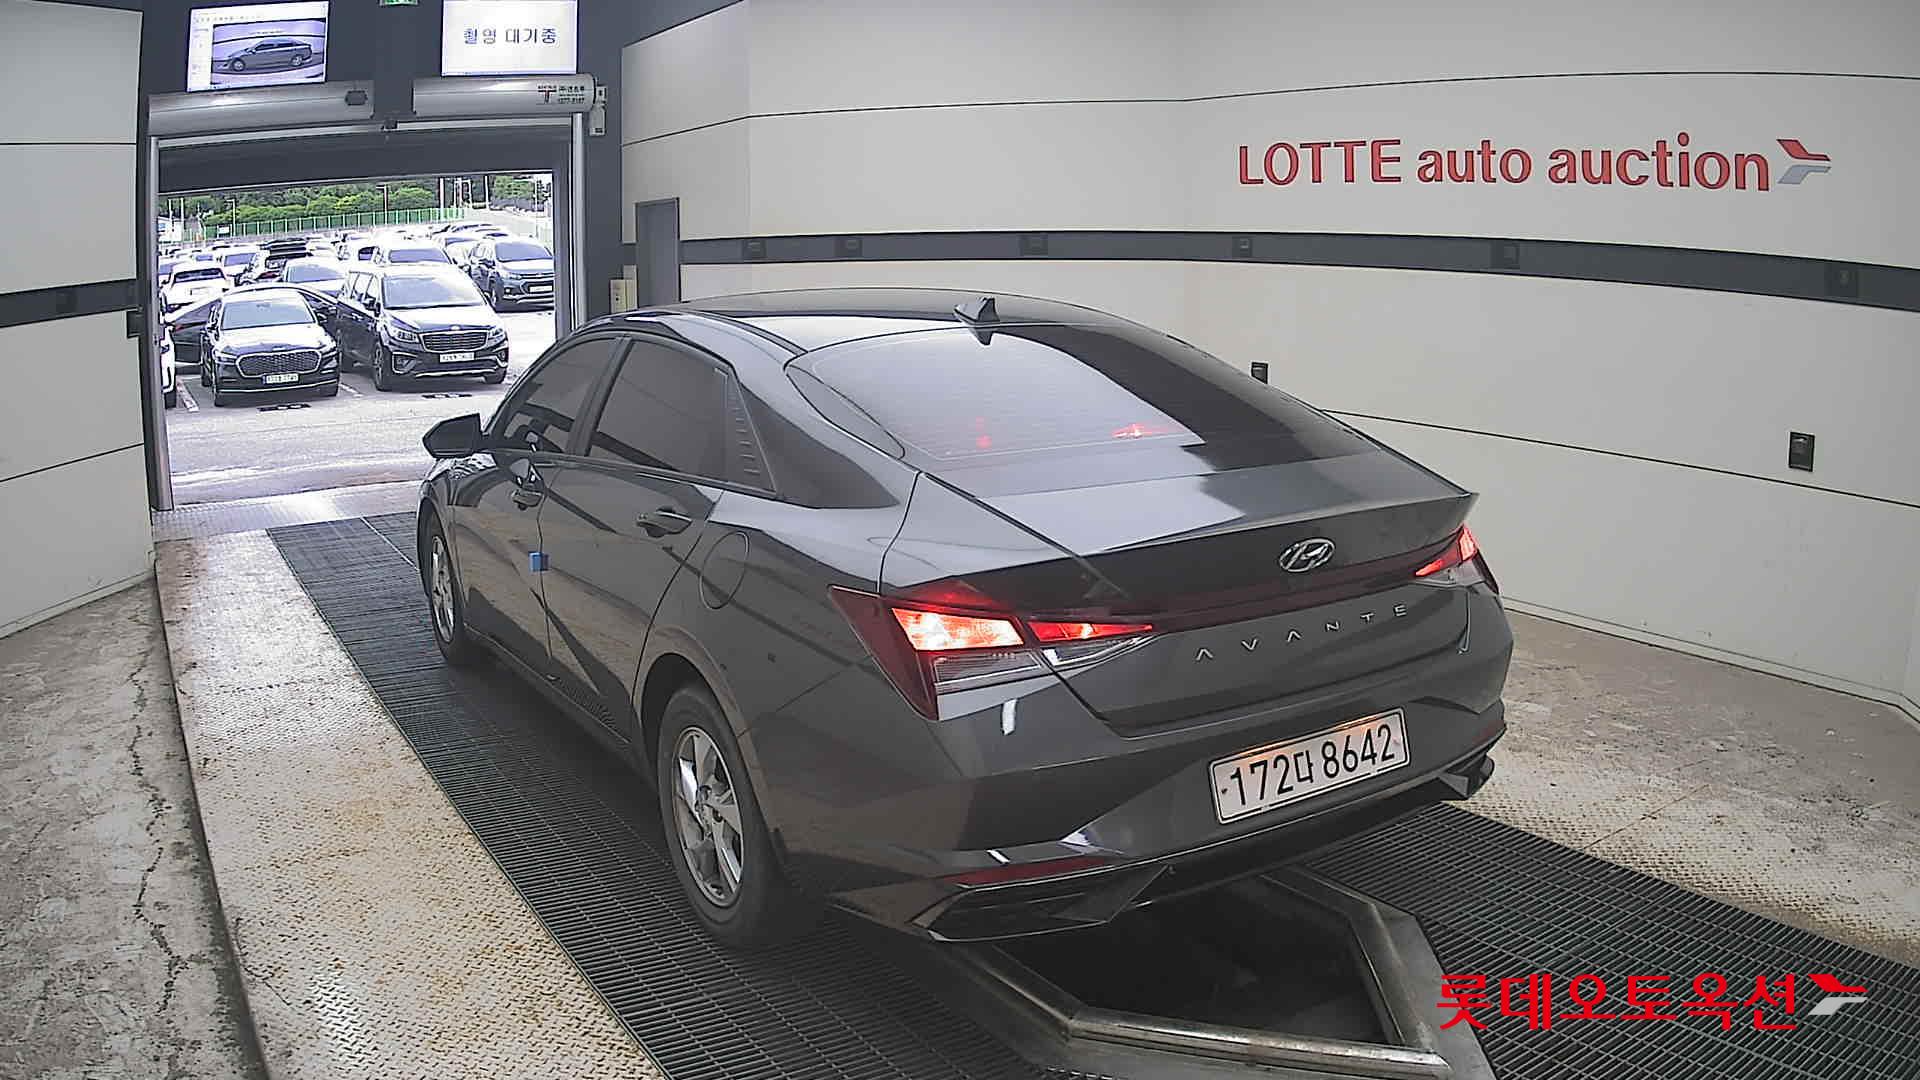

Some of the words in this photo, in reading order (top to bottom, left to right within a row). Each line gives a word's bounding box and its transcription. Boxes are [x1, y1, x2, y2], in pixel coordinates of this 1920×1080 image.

[505, 28, 557, 44] 대기중
[1239, 139, 1401, 185] LOTTE
[1417, 139, 1532, 184] auto
[1548, 131, 1770, 191] auction
[1195, 604, 1407, 661] AVANTE
[1321, 723, 1395, 779] 8642
